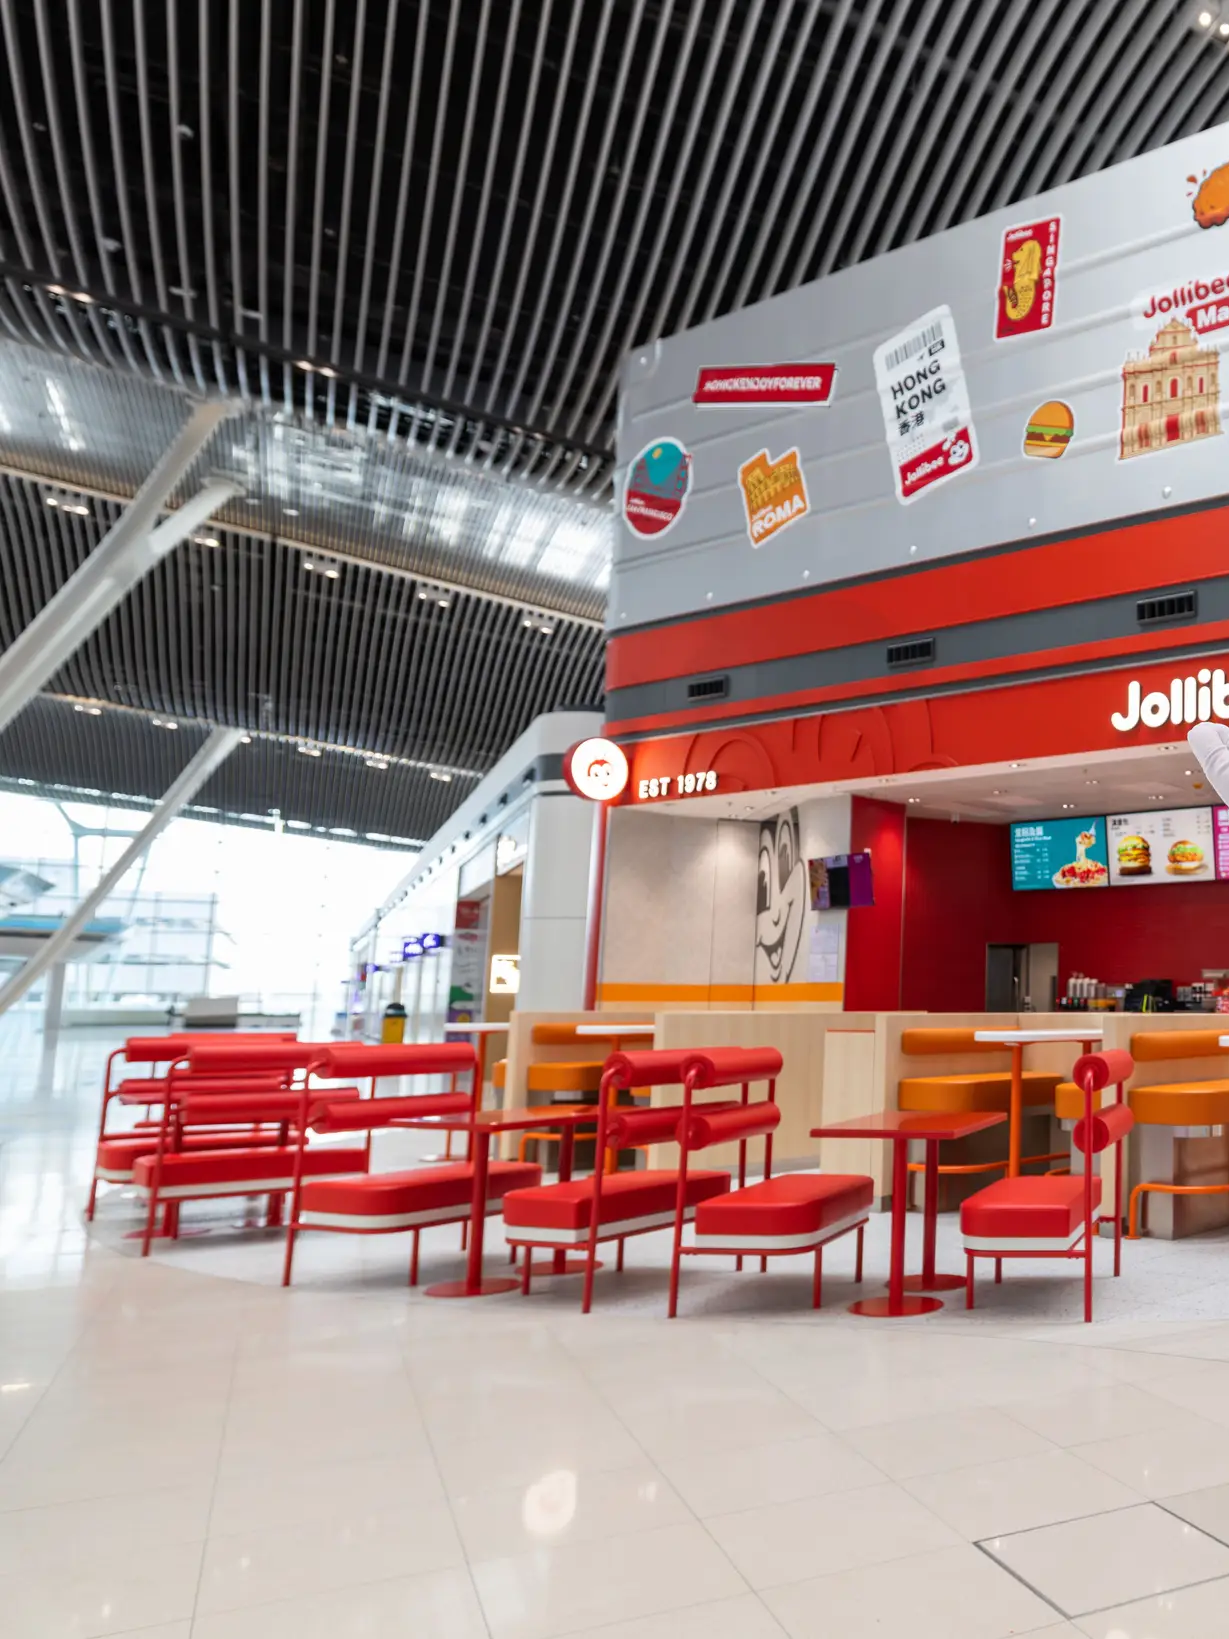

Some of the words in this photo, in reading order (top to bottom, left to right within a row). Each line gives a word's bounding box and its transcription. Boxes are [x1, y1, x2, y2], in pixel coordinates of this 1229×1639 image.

[1041, 221, 1057, 326] SINGAPORE
[891, 360, 942, 401] HONG
[895, 378, 947, 420] KONG
[898, 410, 926, 437] 香港
[904, 454, 945, 486] Jollibee
[752, 494, 805, 539] ROMA
[638, 776, 671, 799] EST
[677, 770, 718, 794] 1978
